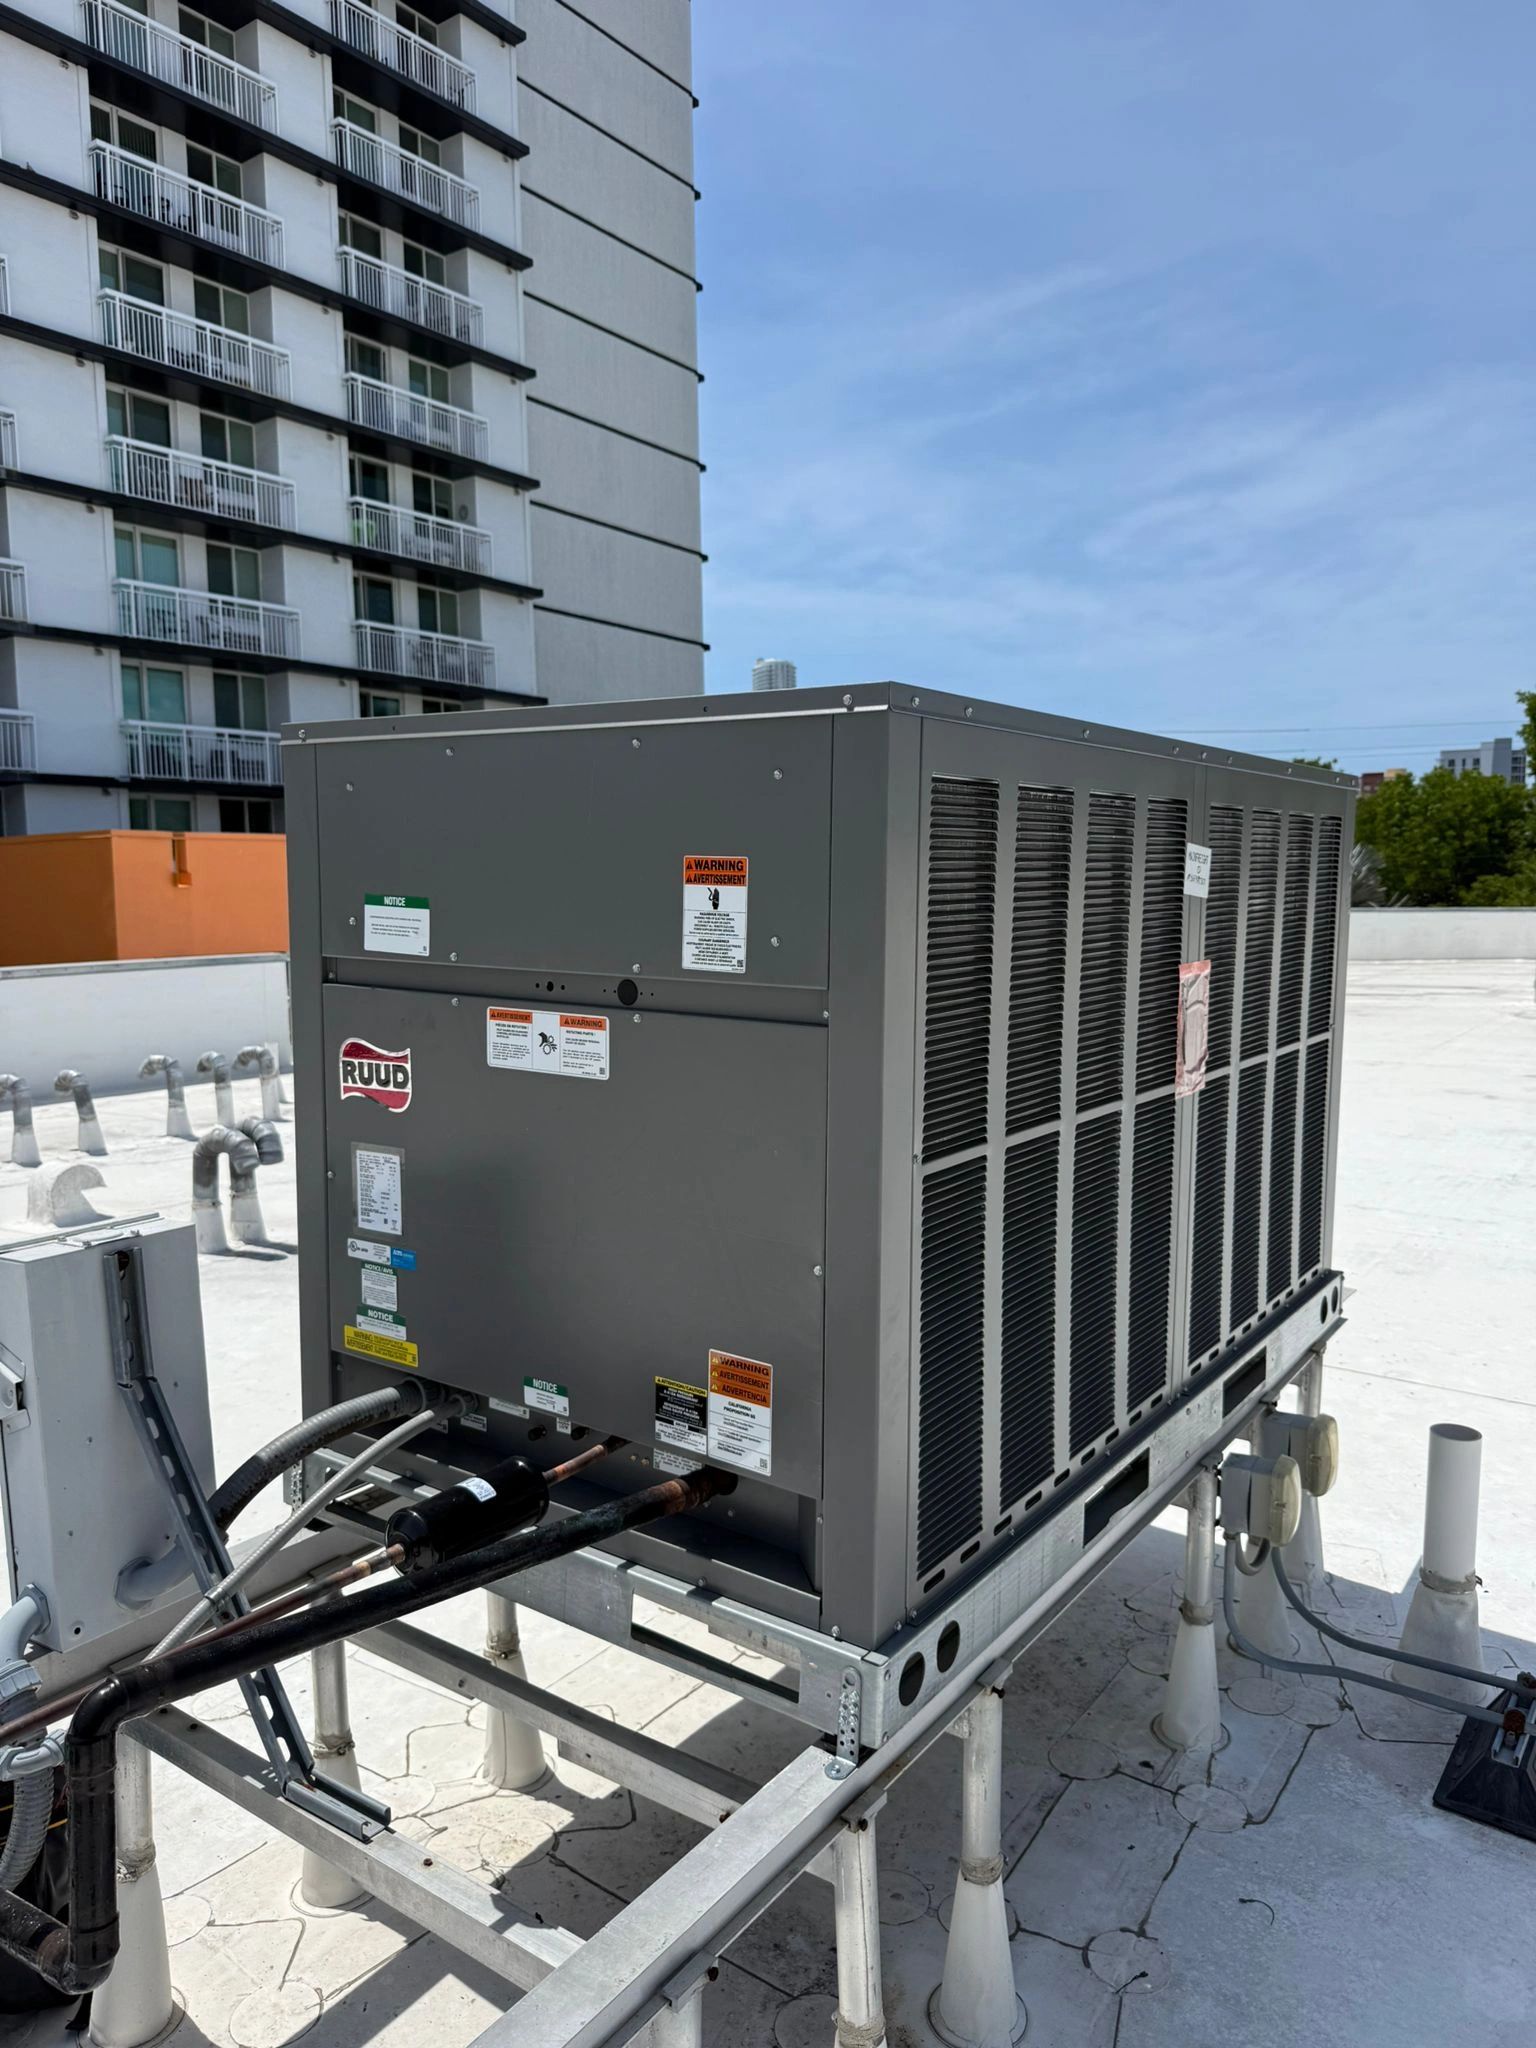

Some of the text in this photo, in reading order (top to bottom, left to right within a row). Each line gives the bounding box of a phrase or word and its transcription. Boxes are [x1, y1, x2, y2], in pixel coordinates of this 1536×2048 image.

[694, 859, 744, 871] WARNING
[693, 873, 746, 885] AVERTISSEMENT
[384, 896, 406, 907] NOTICE
[570, 1017, 603, 1028] WARNING
[342, 1060, 410, 1090] RUUD
[368, 1309, 394, 1323] NOTICE
[720, 1356, 770, 1376] WARNING
[533, 1378, 558, 1393] NOTICE
[719, 1370, 769, 1390] AVERTISSEMENT
[721, 1384, 768, 1404] ADVERTENCIA
